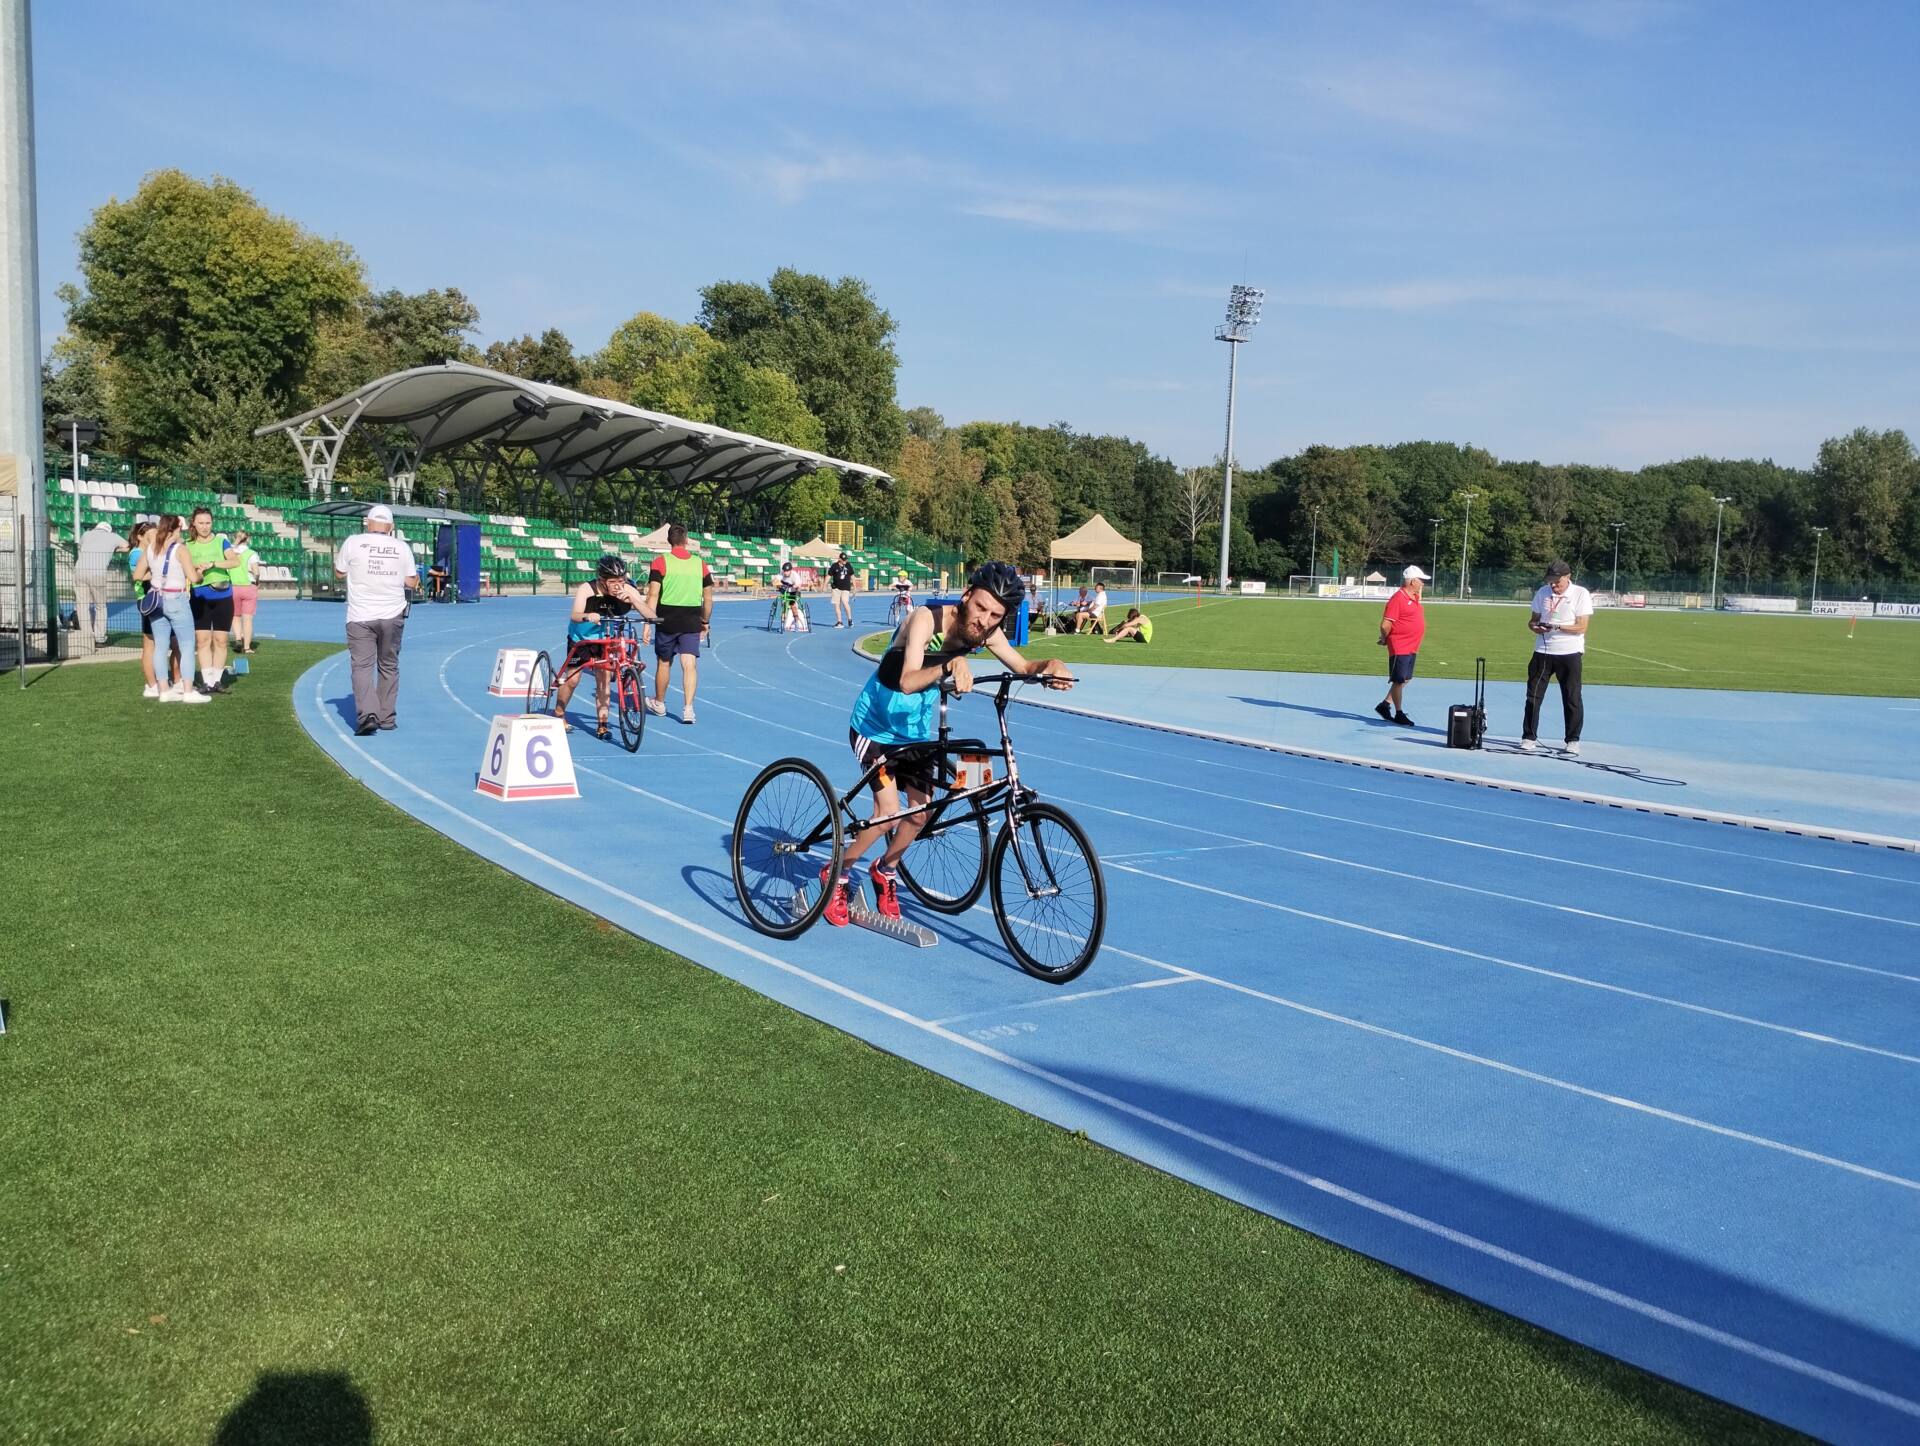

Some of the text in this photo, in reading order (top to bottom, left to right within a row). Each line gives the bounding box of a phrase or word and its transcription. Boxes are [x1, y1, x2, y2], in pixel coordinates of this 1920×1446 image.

[369, 546, 400, 555] FUEL
[495, 658, 503, 683] 5
[514, 659, 531, 685] 5
[491, 733, 505, 776] 6
[525, 734, 554, 779] 6
